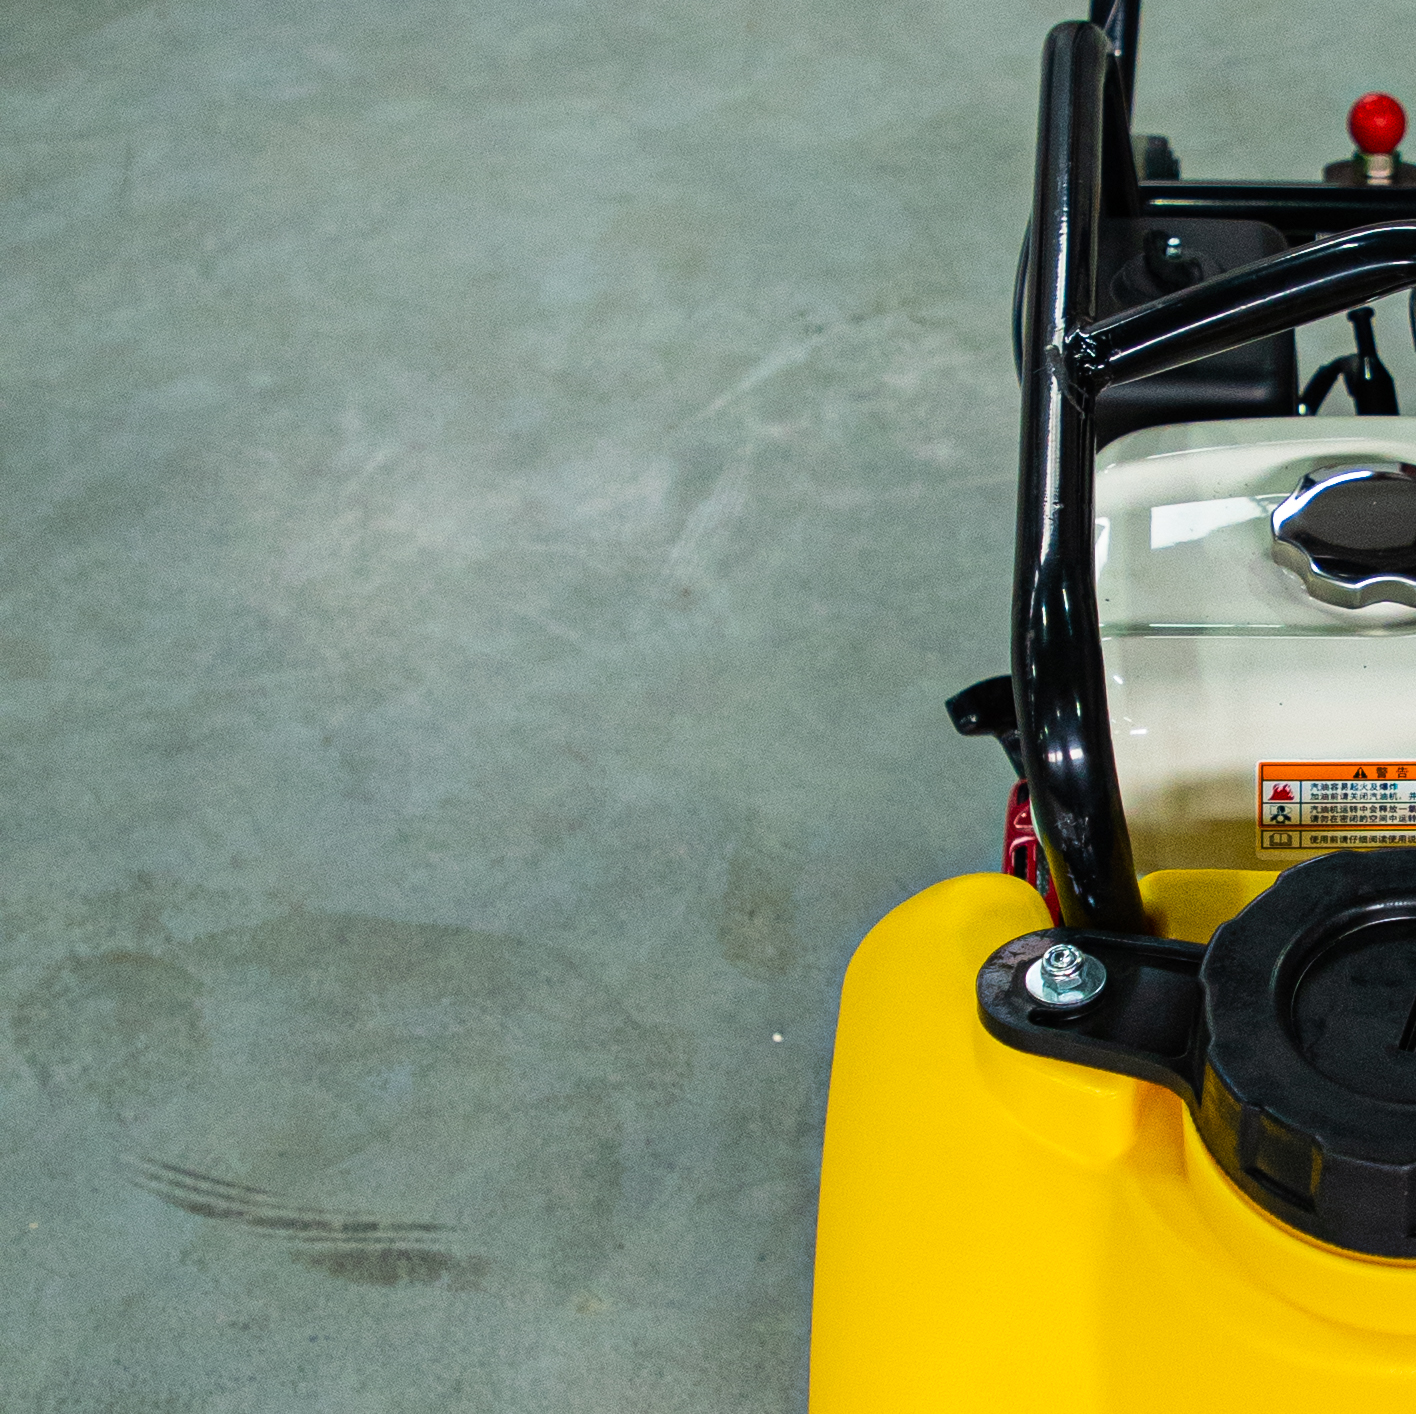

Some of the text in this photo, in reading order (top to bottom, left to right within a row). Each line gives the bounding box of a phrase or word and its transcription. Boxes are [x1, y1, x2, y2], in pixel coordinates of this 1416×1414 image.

[1310, 782, 1398, 791] 汽油容易起火及爆炸
